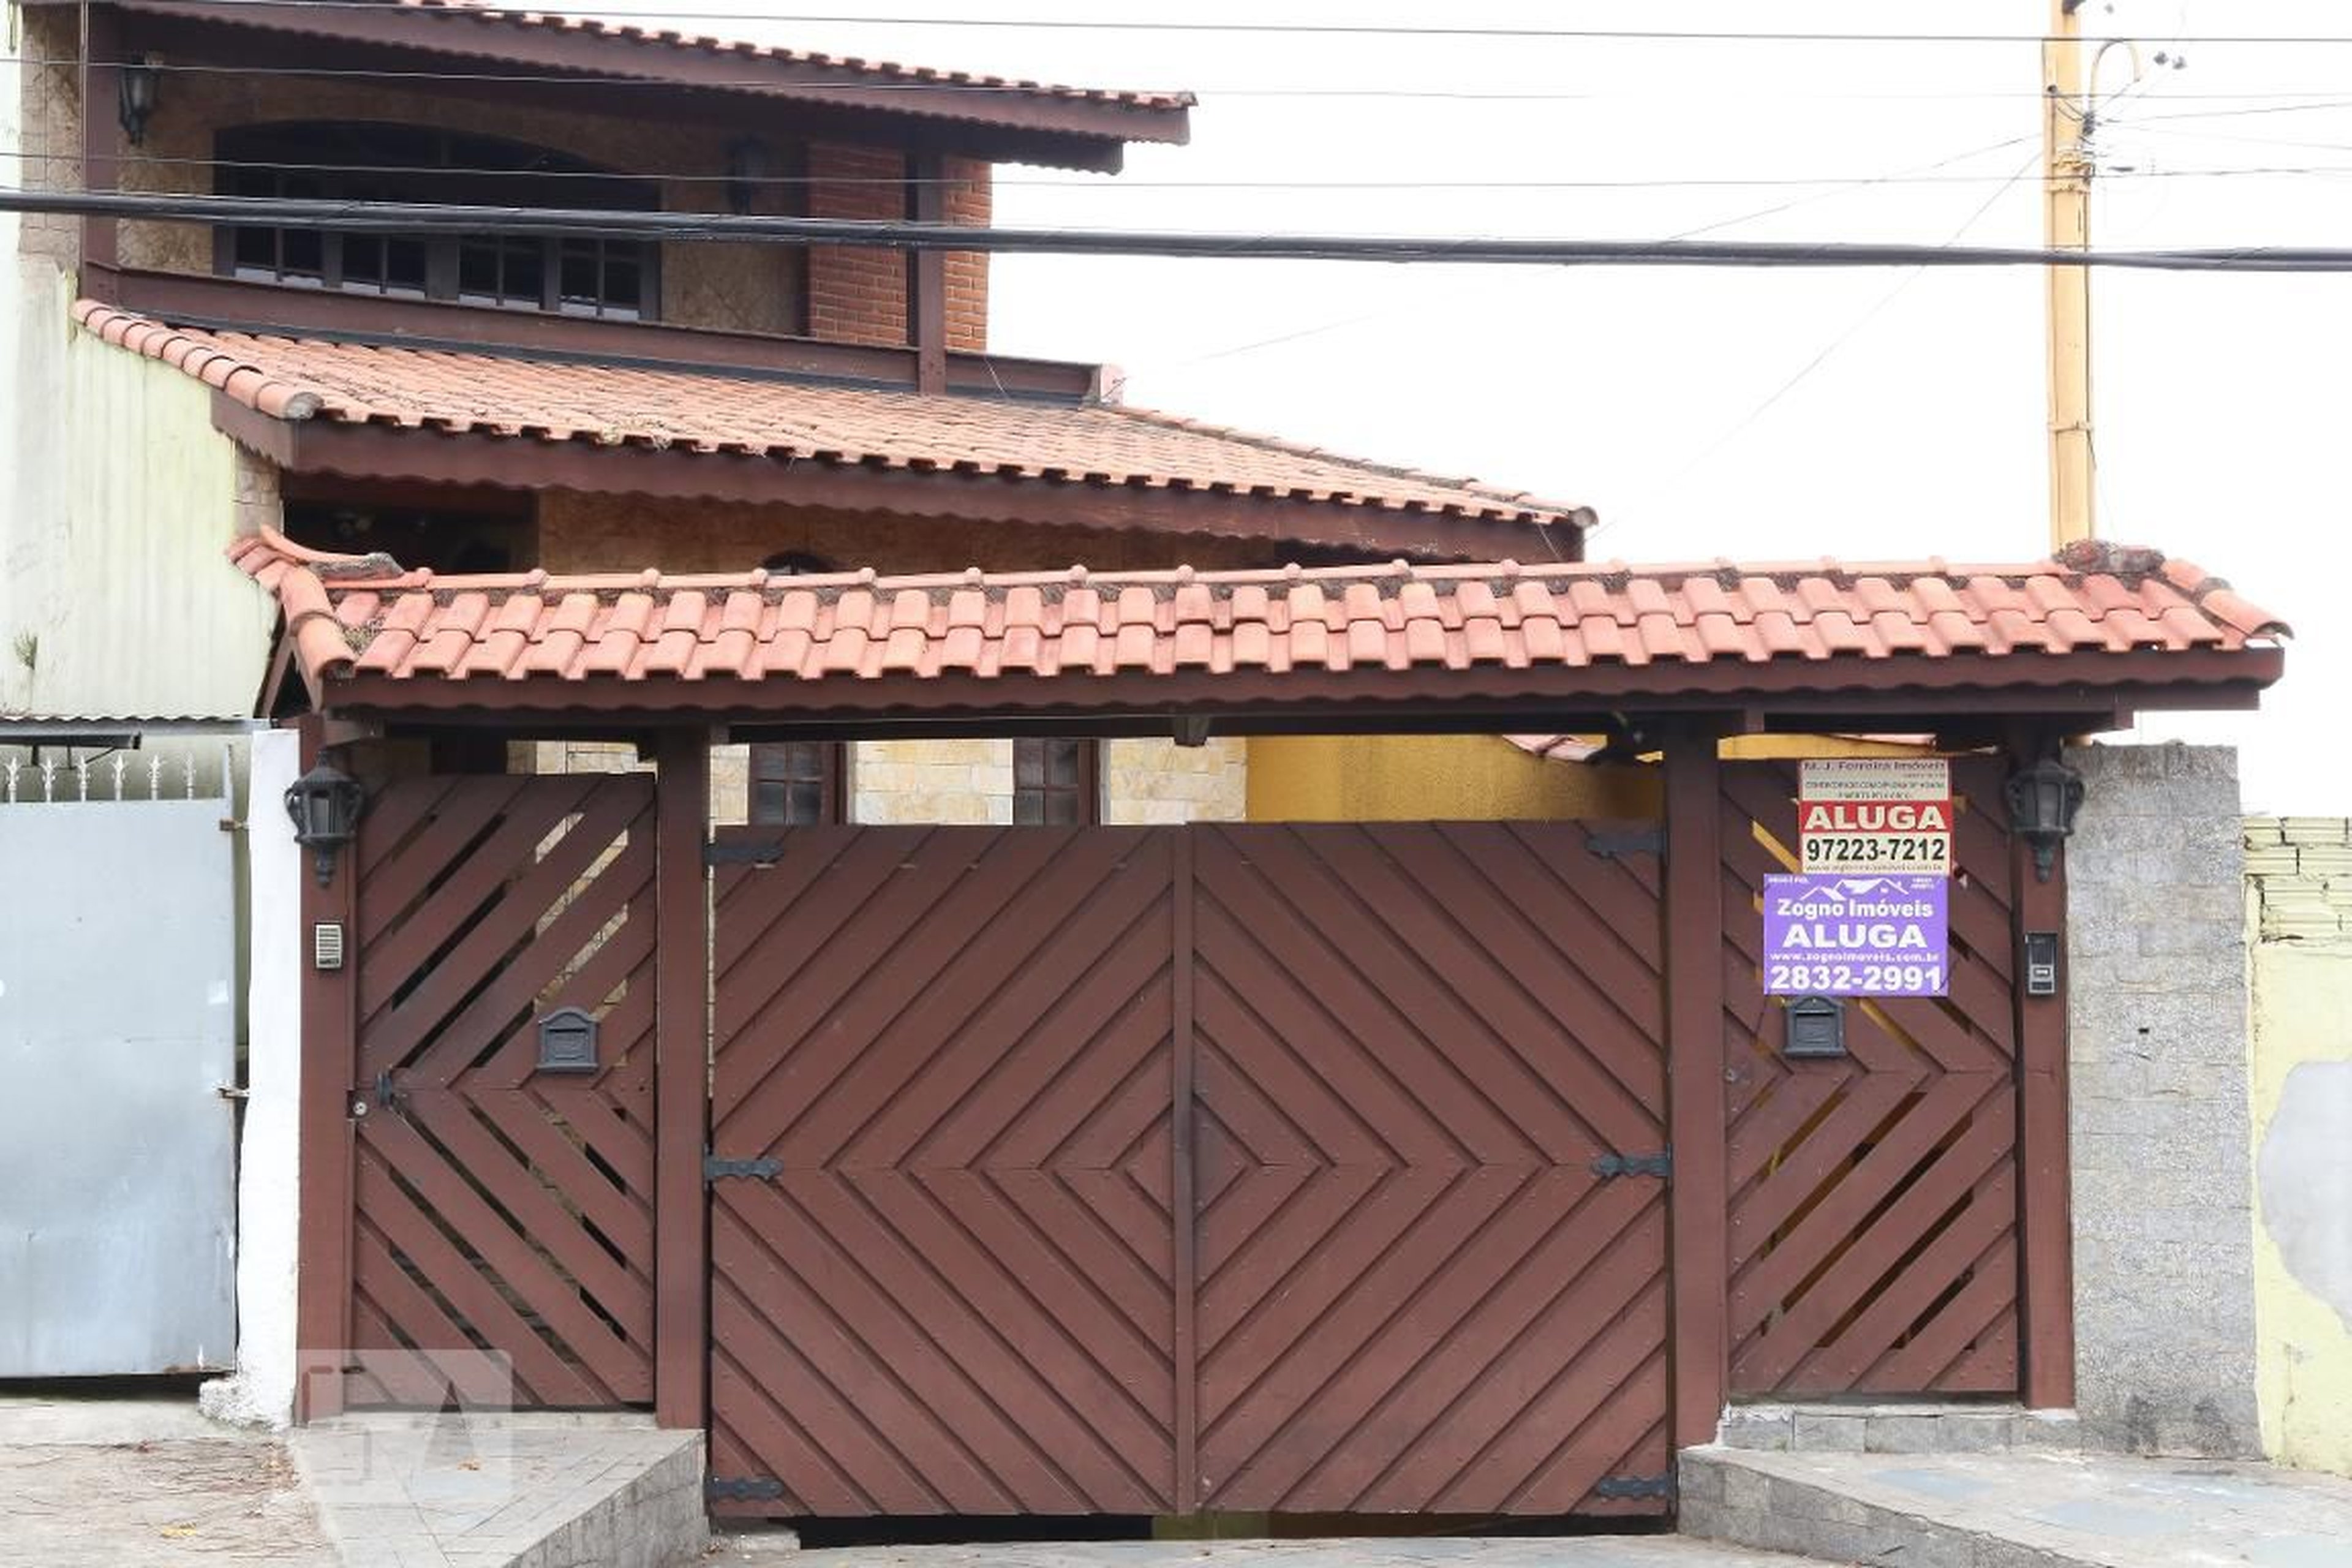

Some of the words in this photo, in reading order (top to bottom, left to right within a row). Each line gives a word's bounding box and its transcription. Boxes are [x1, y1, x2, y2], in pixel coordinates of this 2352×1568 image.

[1804, 805, 1947, 829] ALUGA
[1807, 839, 1945, 861] 97223-7212
[1777, 898, 1844, 919] Zogno
[1849, 898, 1934, 918] Imóveis
[1782, 924, 1928, 948] ALUGA
[1770, 952, 1939, 963] www.zognoimoveis.com.br
[1770, 965, 1941, 990] 2832-2991
